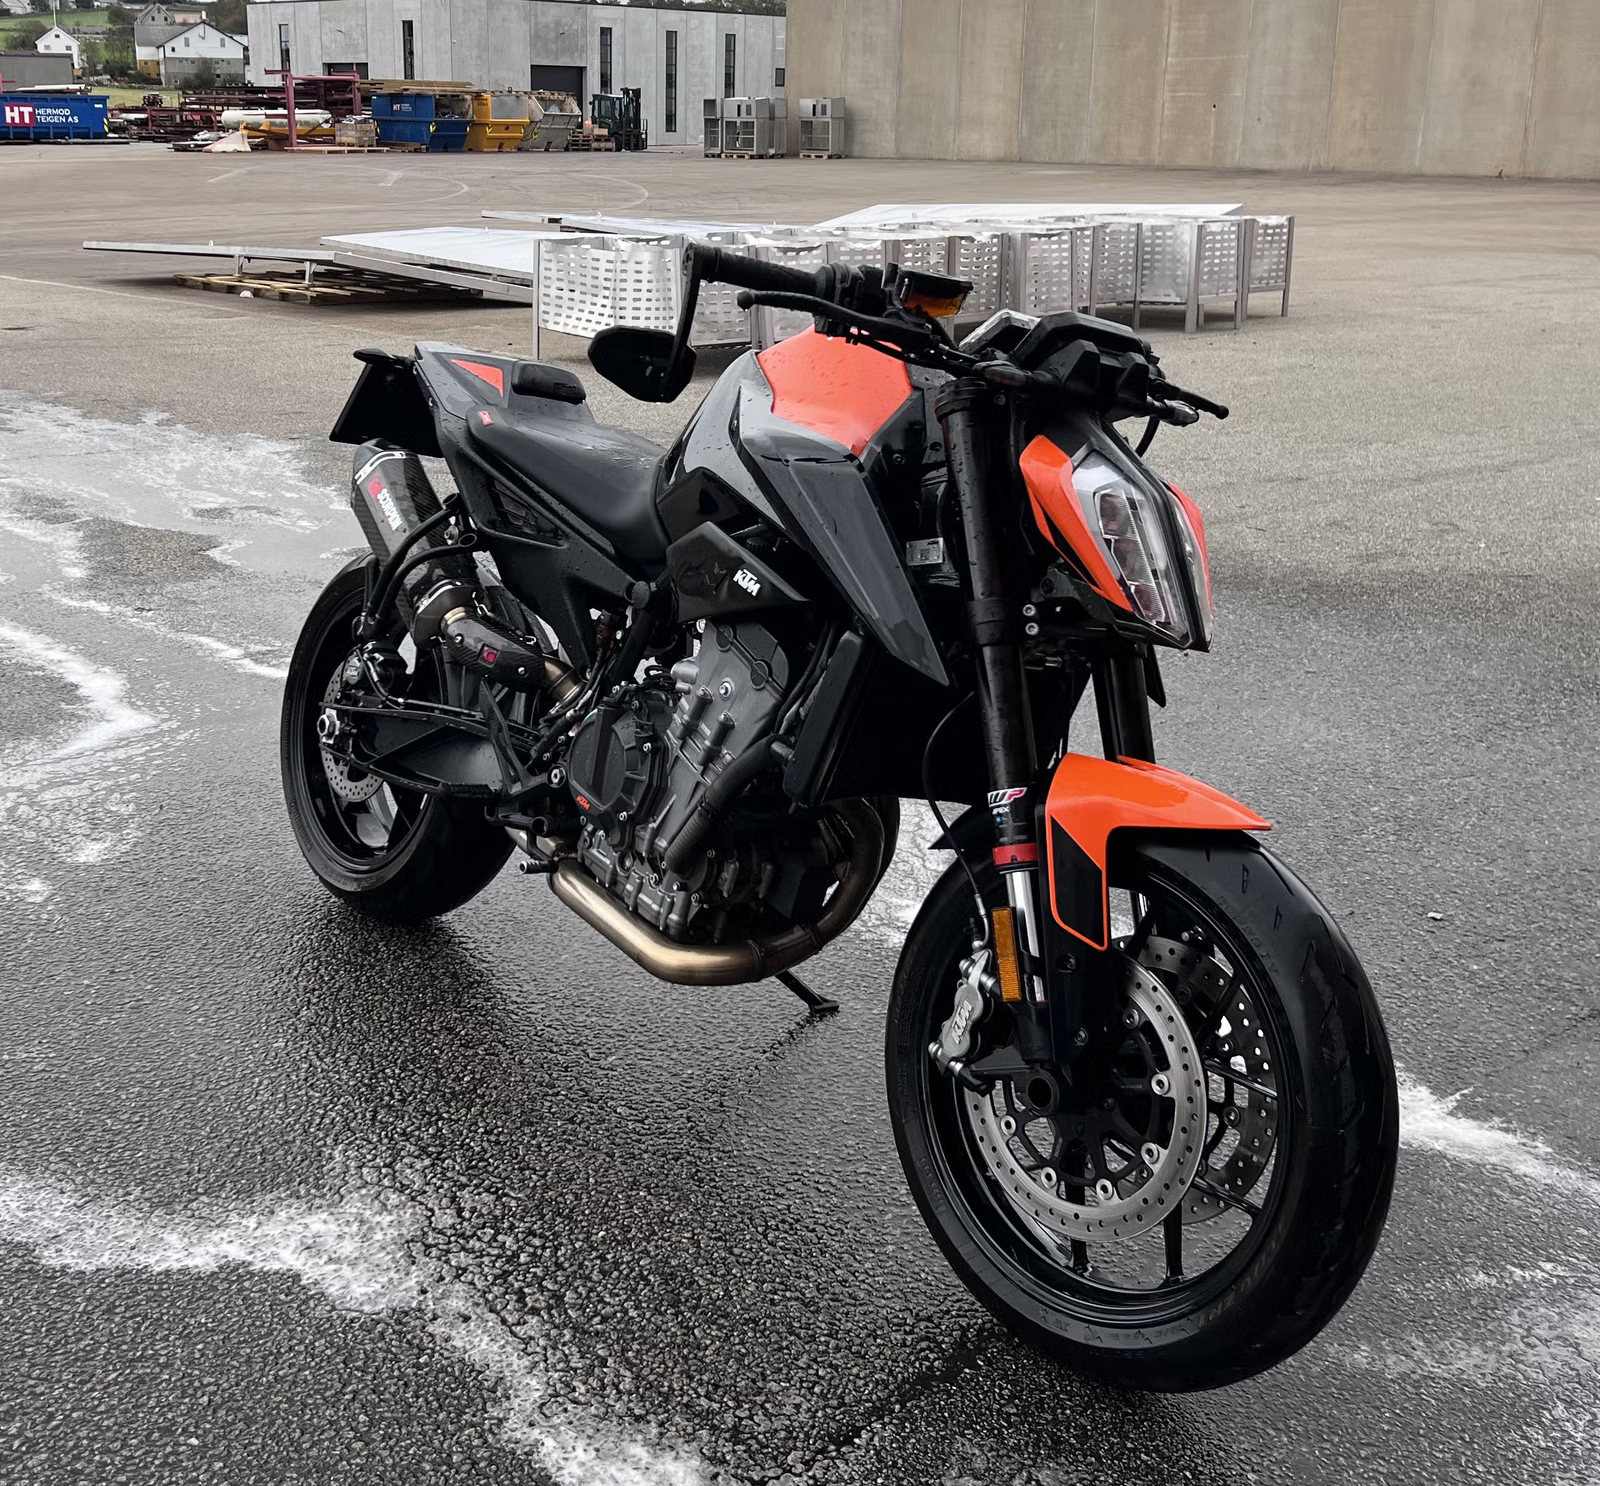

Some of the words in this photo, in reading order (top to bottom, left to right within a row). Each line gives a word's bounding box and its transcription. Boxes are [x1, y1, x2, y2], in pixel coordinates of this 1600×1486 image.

[5, 106, 33, 124] HT
[732, 568, 761, 597] KTM
[987, 787, 1027, 807] WP
[951, 999, 973, 1045] KTM
